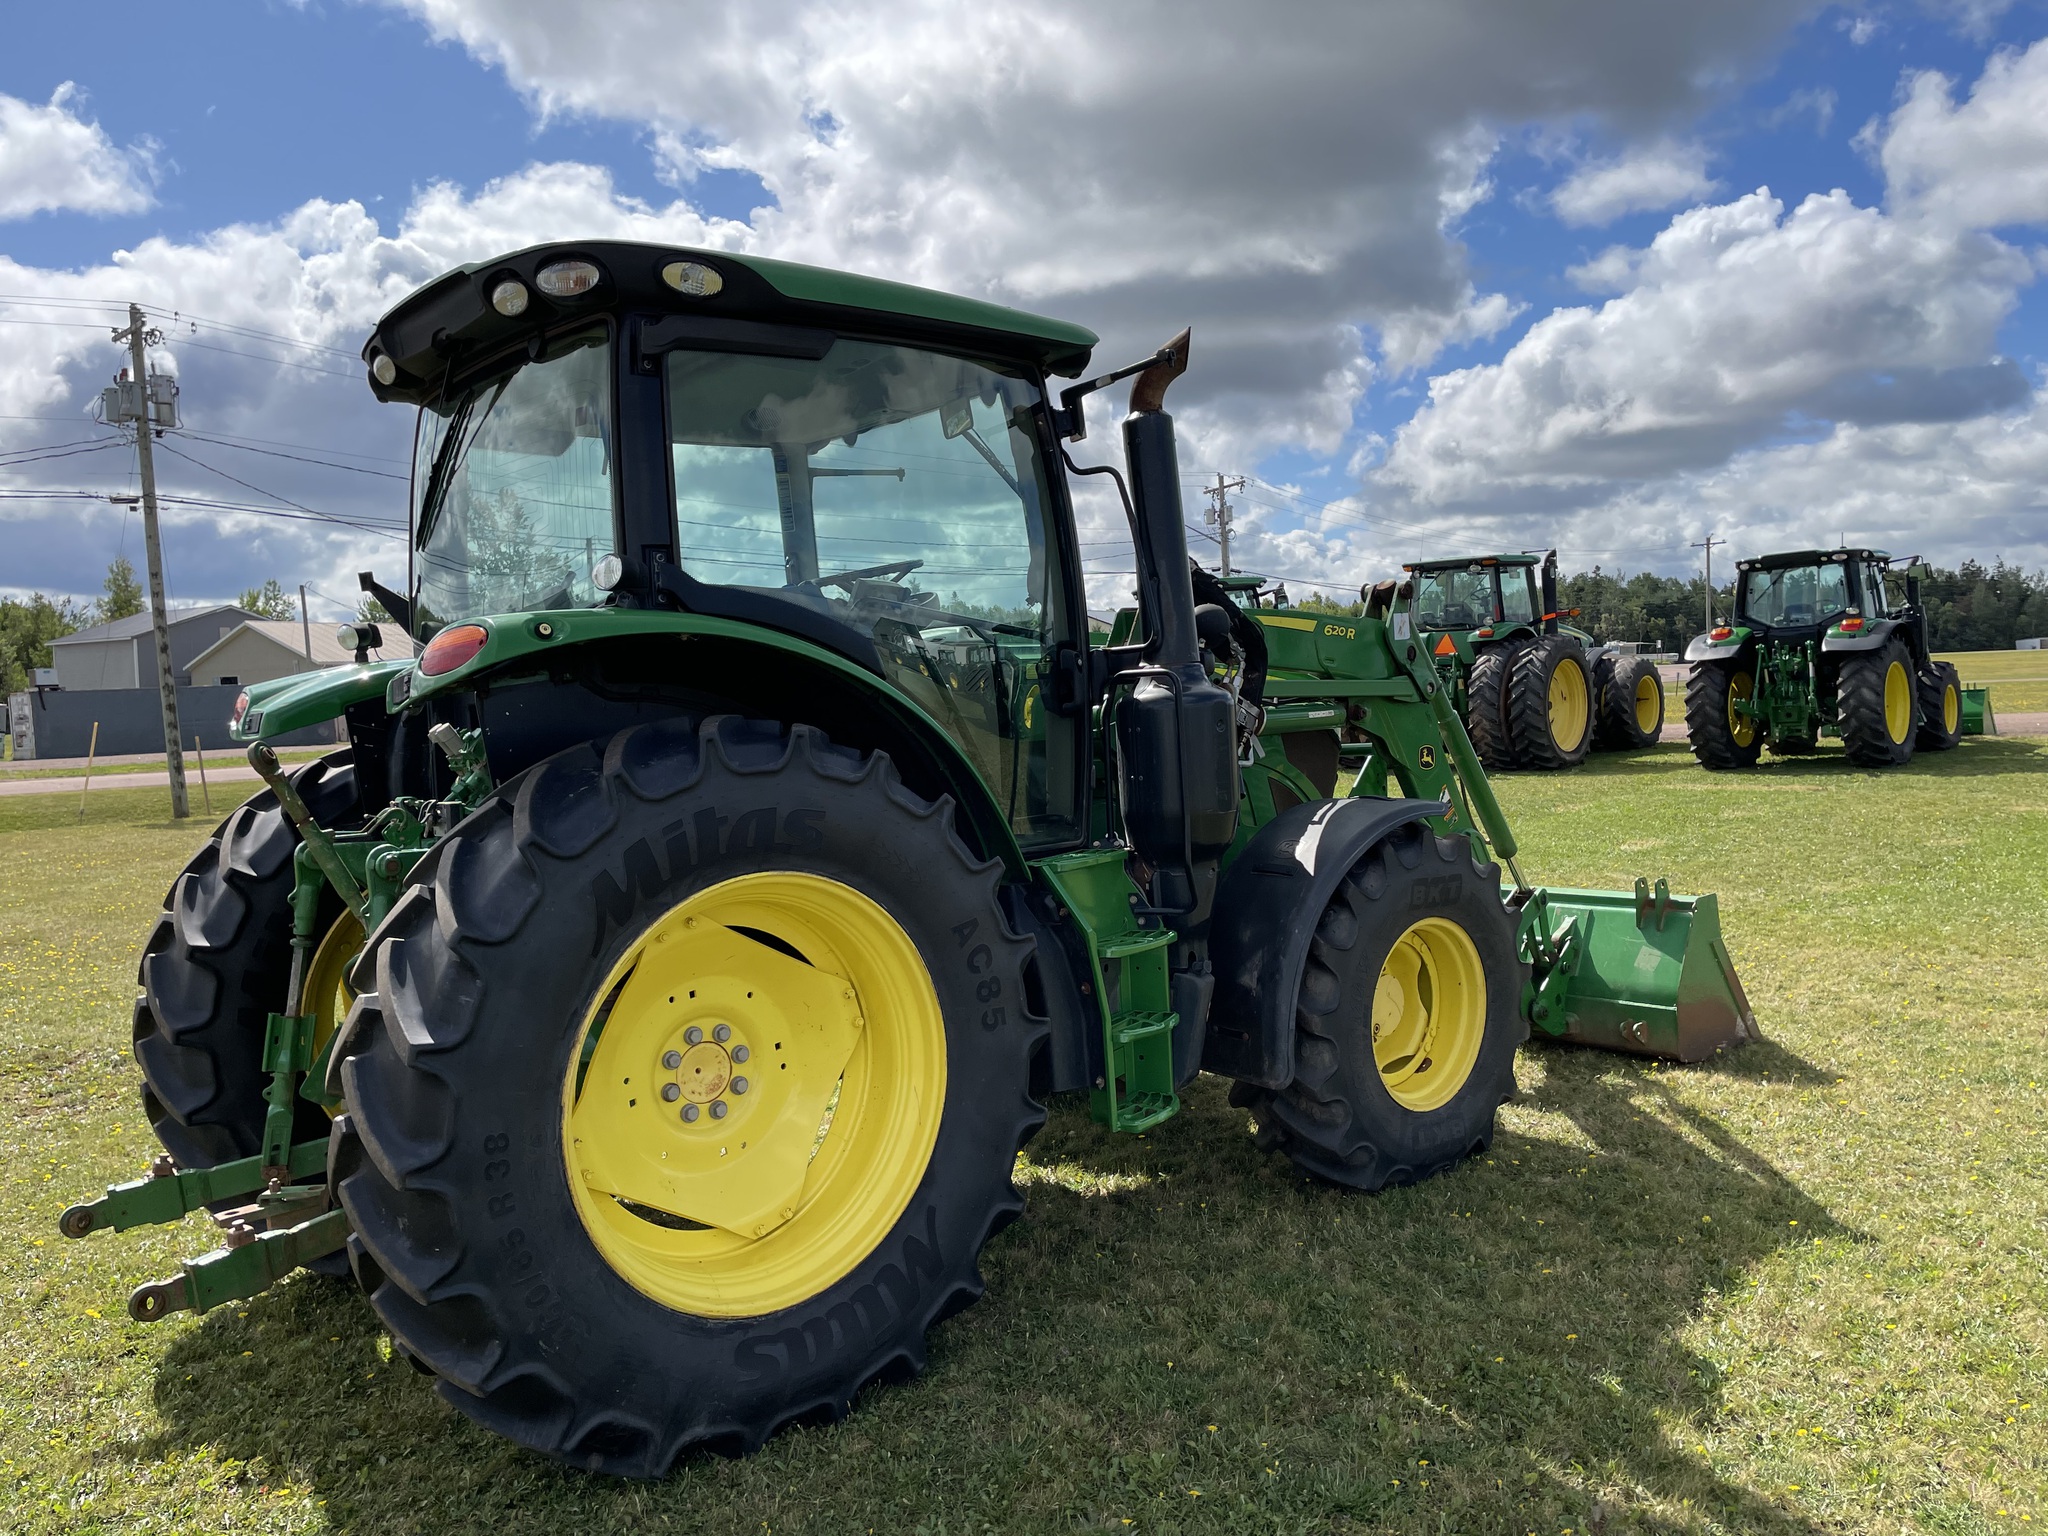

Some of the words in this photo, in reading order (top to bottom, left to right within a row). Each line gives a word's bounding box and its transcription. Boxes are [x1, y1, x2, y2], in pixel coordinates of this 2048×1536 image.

[1324, 624, 1346, 636] 620
[1346, 627, 1356, 640] R
[590, 806, 826, 960] Mitas
[950, 916, 1007, 1032] AC85
[483, 1132, 512, 1182] 38
[488, 1191, 517, 1220] R
